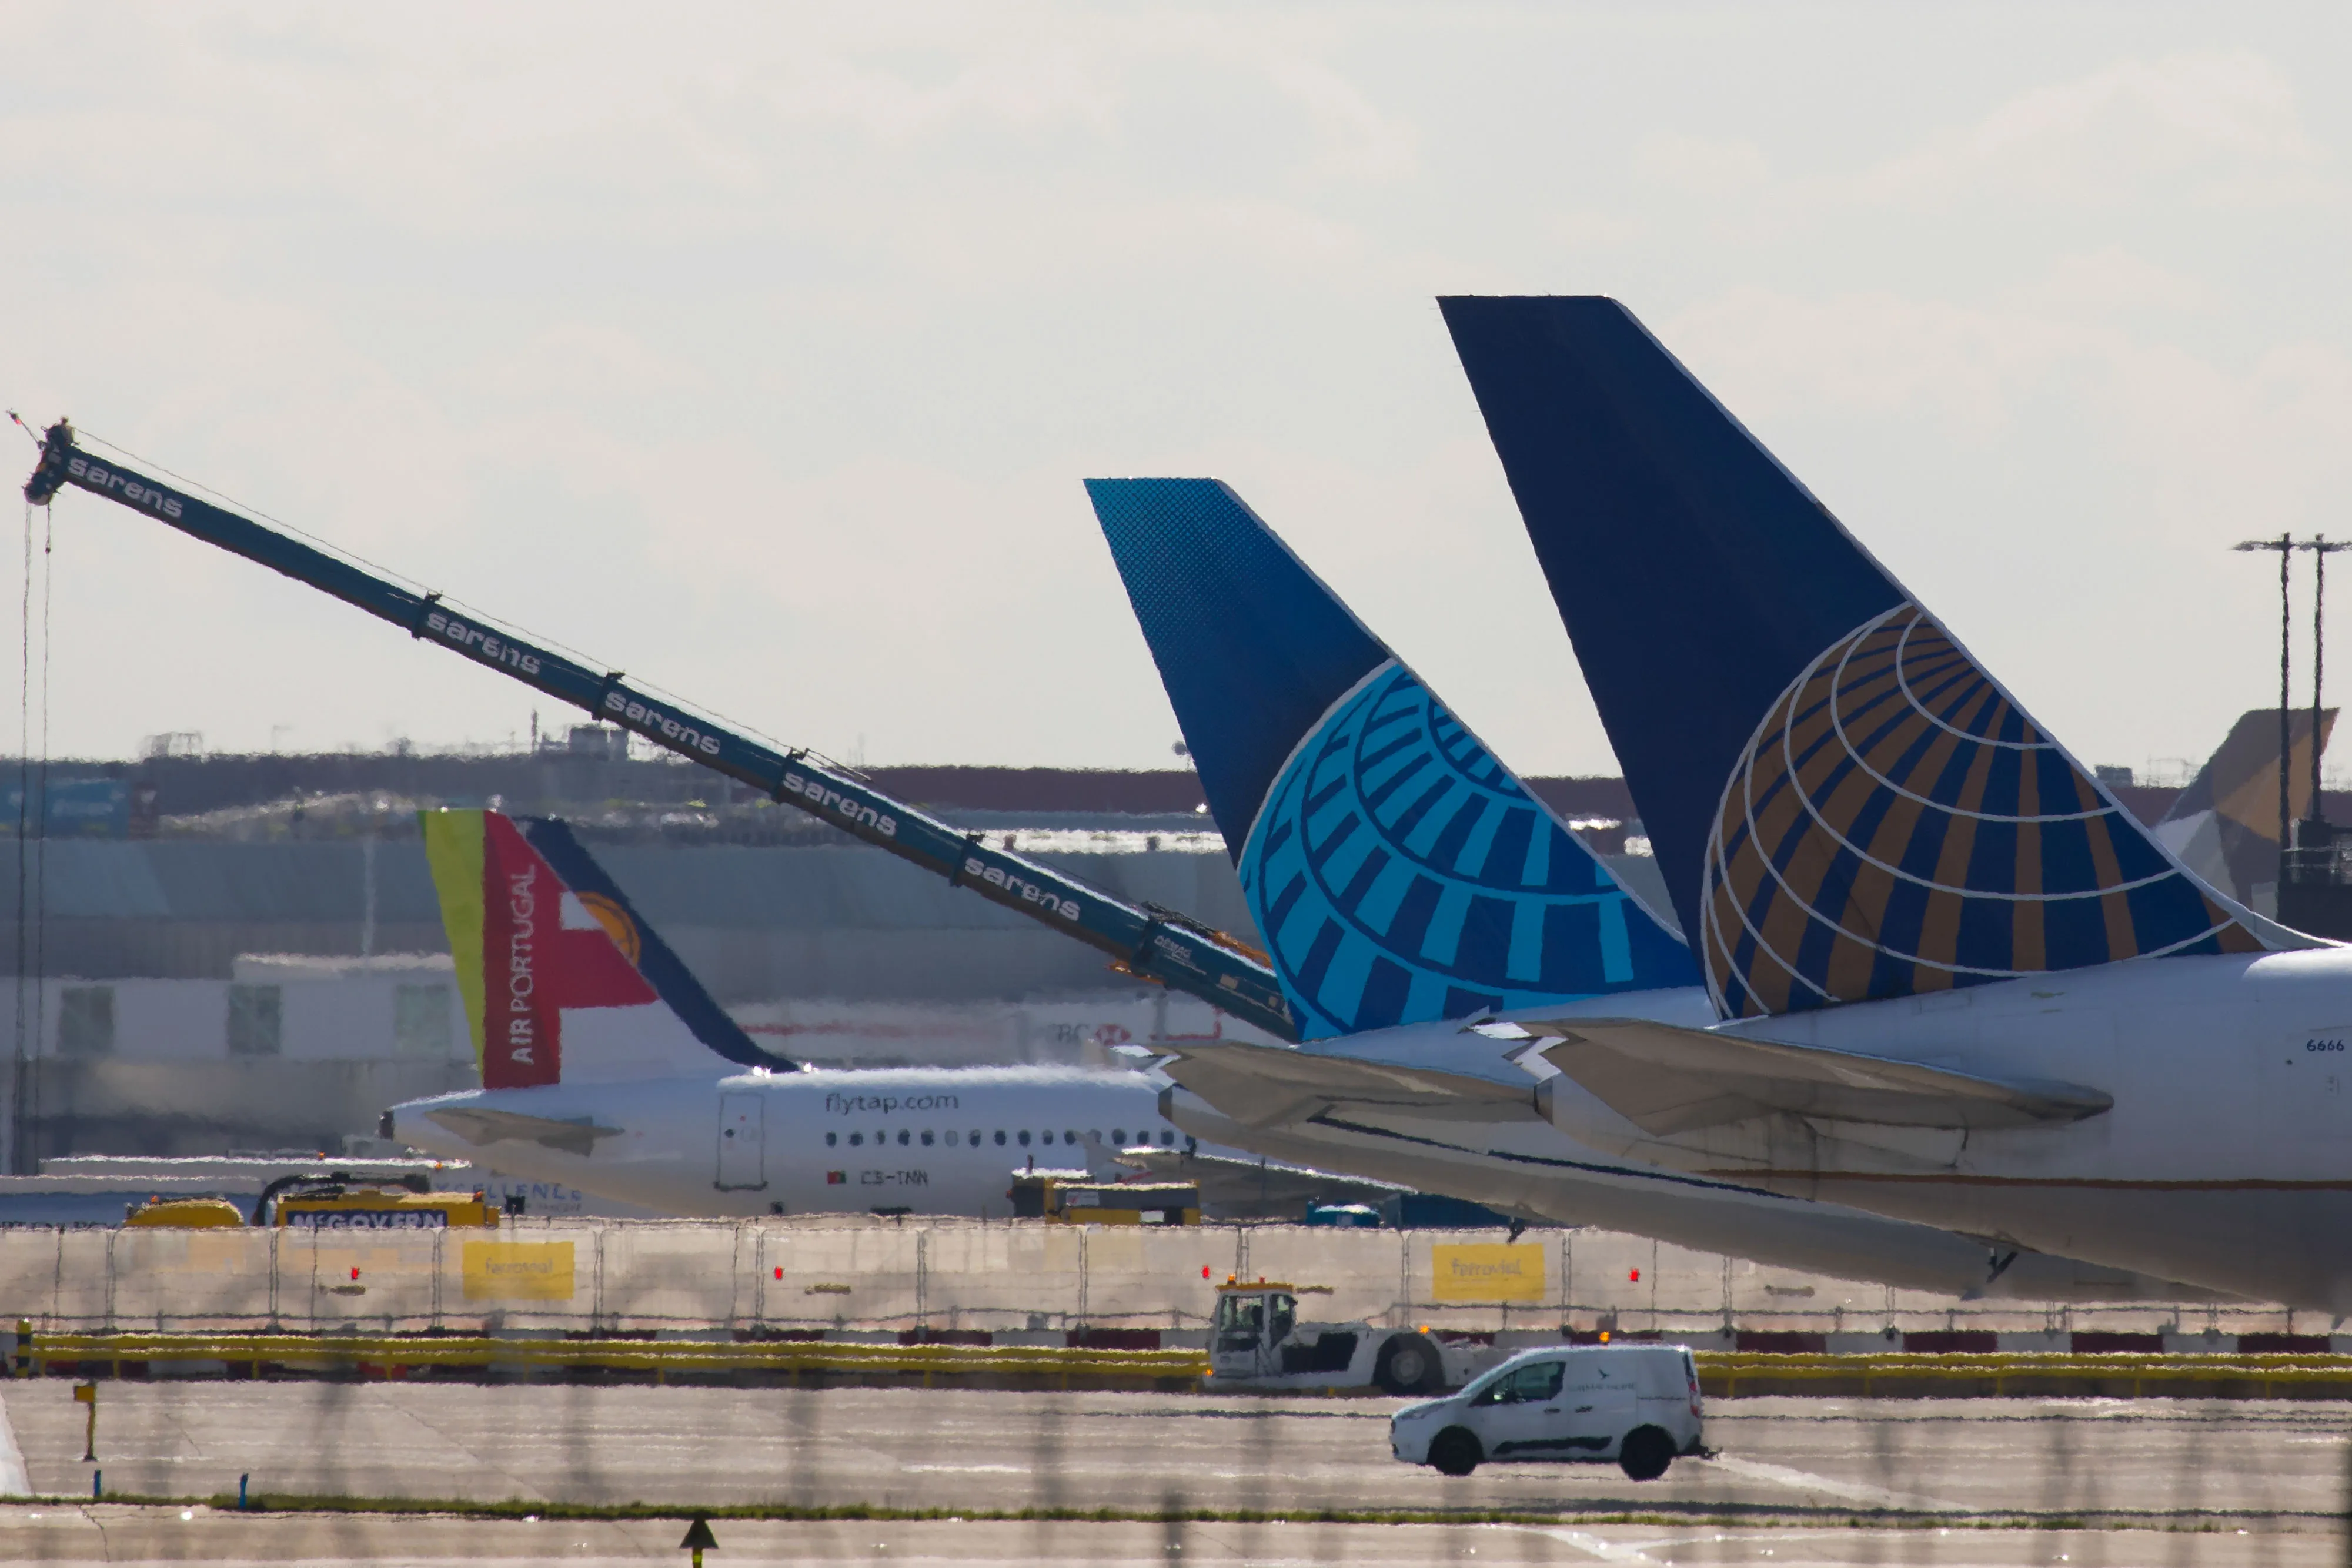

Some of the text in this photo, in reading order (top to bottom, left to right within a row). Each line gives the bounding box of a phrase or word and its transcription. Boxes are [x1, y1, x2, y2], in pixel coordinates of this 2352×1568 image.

[67, 457, 183, 519] sarens
[426, 611, 540, 675] sarens
[605, 691, 721, 755] sarens
[783, 772, 897, 837] sarens
[964, 857, 1081, 921] sarens
[509, 864, 536, 1065] AIR PORTUGAL
[2306, 1039, 2345, 1052] 6666
[826, 1092, 960, 1116] flytap.com
[1451, 1258, 1523, 1276] ferrovial
